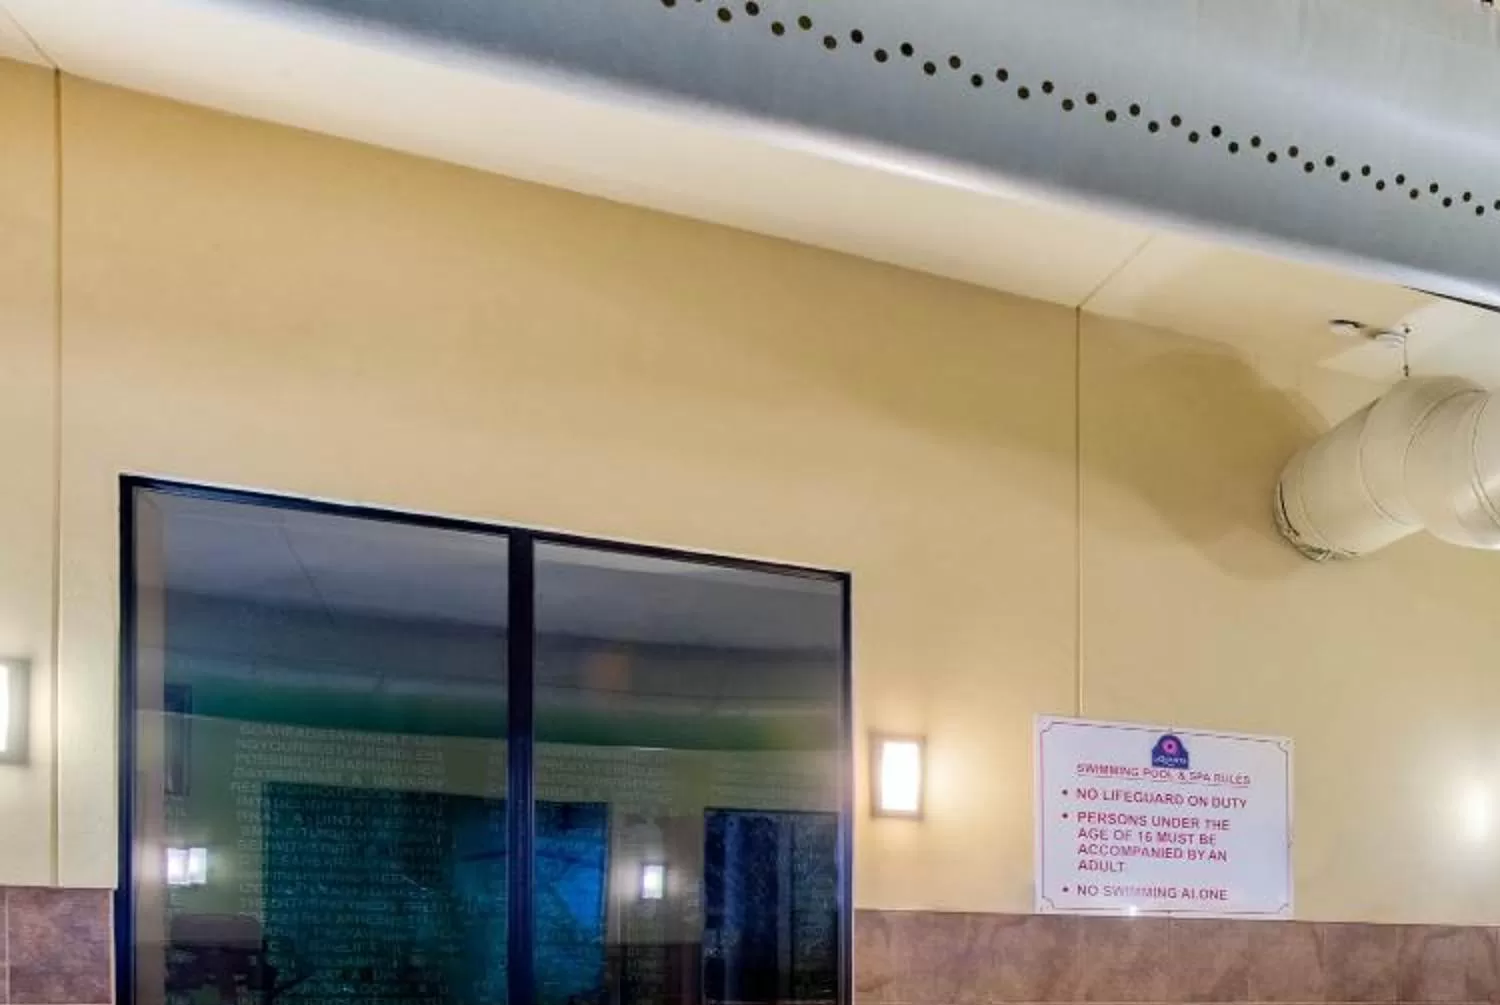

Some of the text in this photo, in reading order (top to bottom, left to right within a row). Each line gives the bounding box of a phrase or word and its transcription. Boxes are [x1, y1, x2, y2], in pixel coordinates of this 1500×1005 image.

[1076, 763, 1252, 785] SWIMMING POOL & SPA RULES
[1076, 788, 1248, 809] NO LIFEGUARD ON DUTY
[1077, 811, 1231, 831] PERSONS UNDER THE
[1077, 828, 1217, 846] AGE OF 16 MUST BE
[1077, 844, 1228, 862] ACCOMPANIED BY AN
[1077, 859, 1125, 873] ADULT
[1077, 884, 1229, 901] NO SWIMMING ALONE
